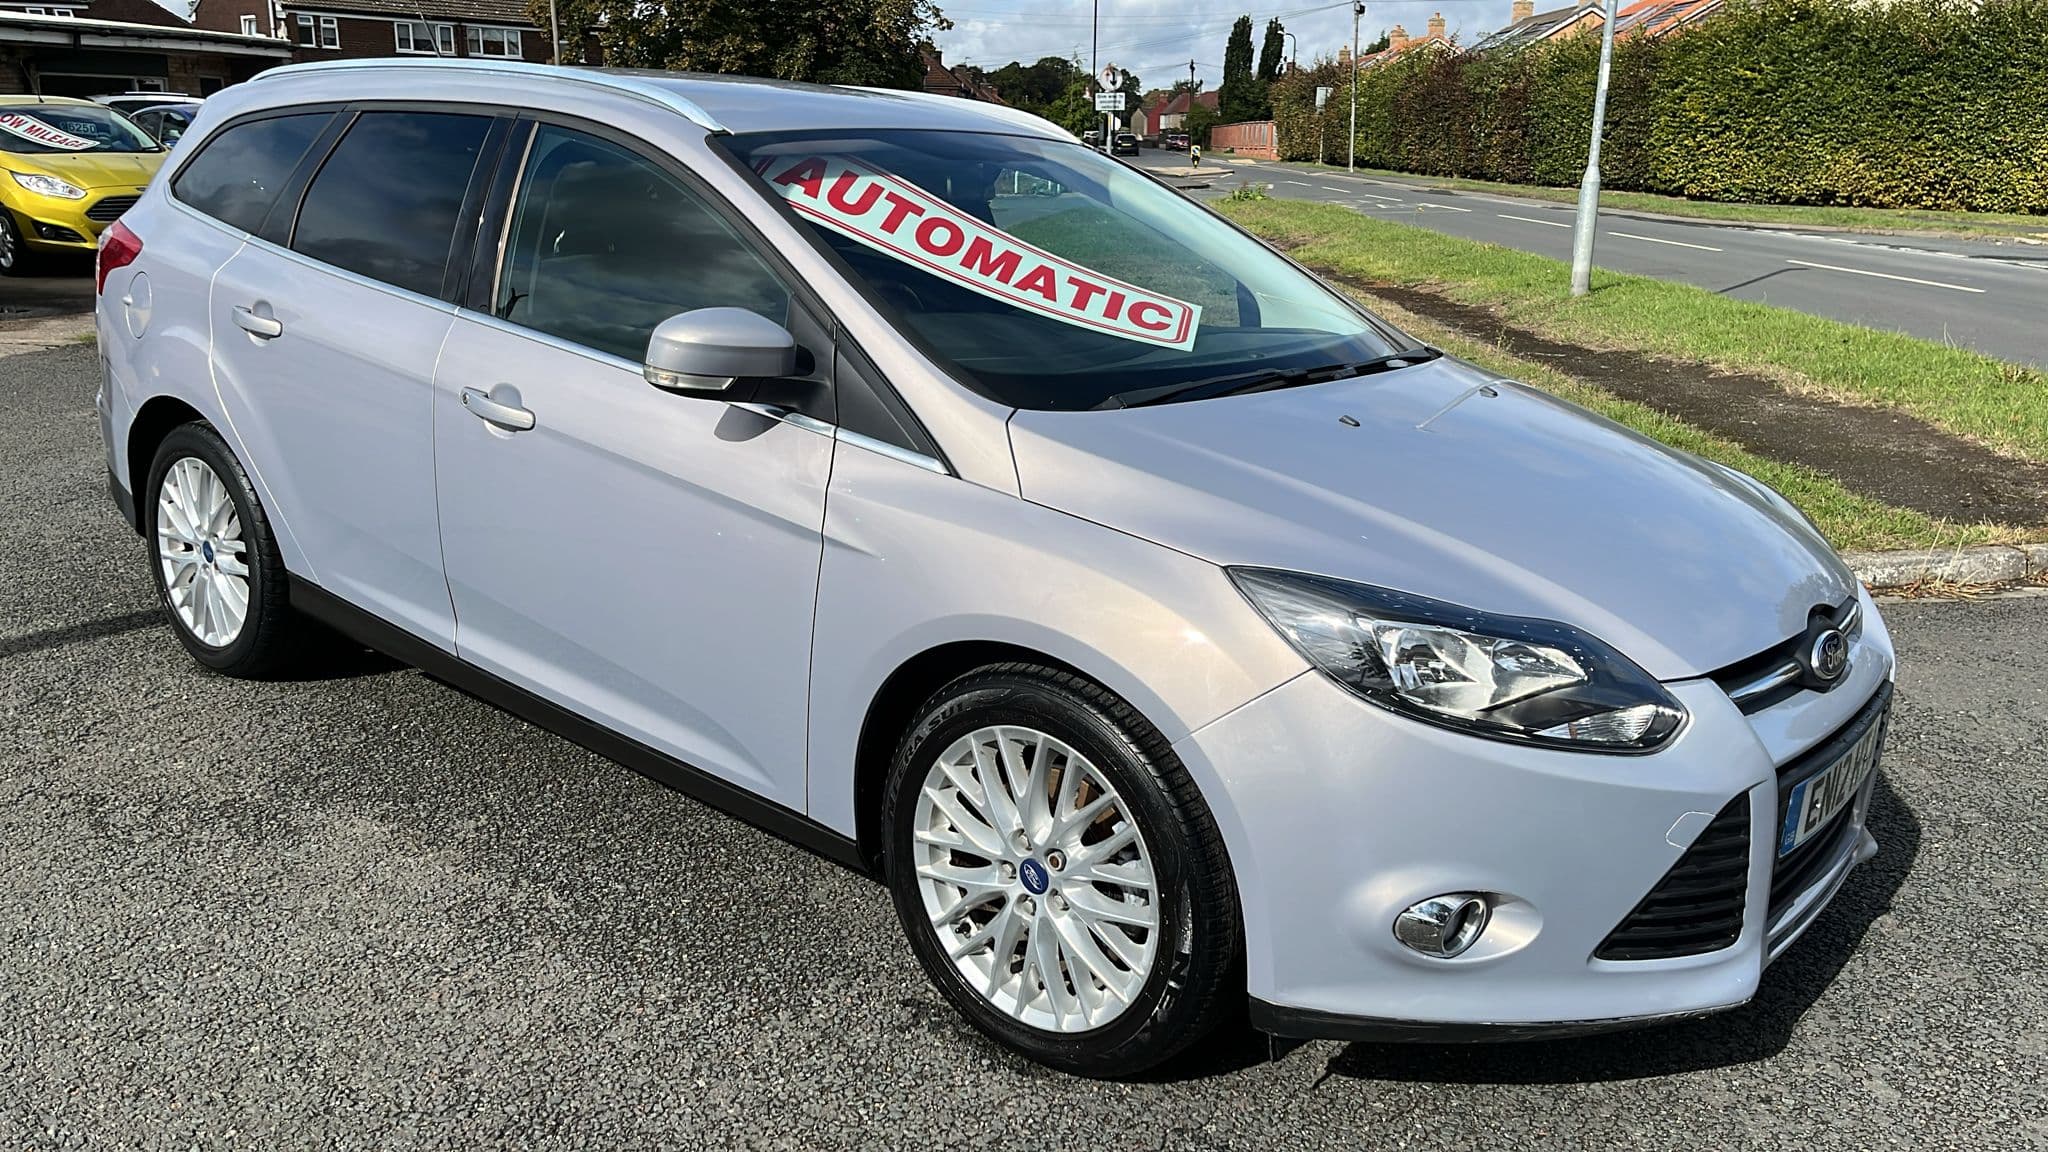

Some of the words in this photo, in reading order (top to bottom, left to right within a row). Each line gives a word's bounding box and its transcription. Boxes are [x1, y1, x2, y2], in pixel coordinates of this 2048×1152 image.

[0, 113, 28, 129] OW
[23, 124, 88, 148] MILEAGE
[772, 156, 1175, 332] AUTOMATIC
